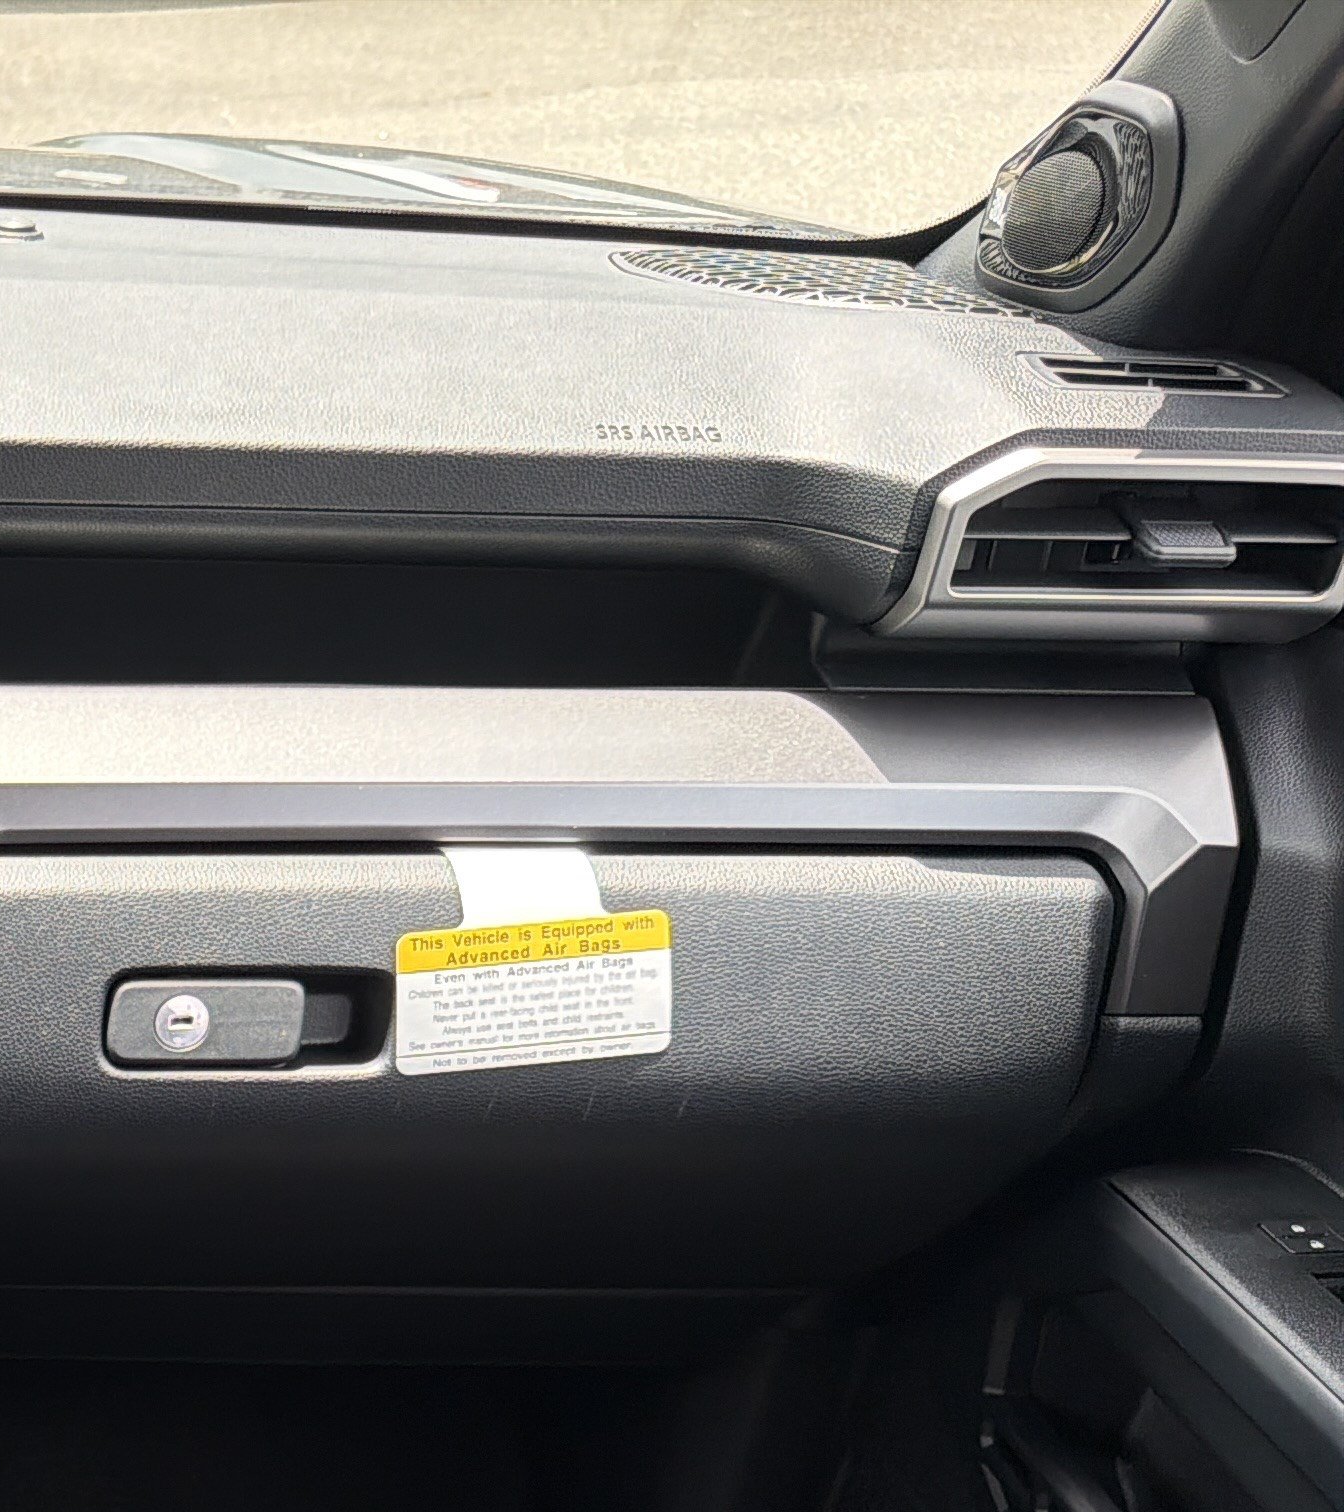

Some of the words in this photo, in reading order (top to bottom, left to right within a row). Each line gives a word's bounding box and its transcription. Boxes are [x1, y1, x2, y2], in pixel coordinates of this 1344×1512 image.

[595, 424, 633, 441] SRS
[640, 424, 722, 443] AIRBAG
[409, 936, 444, 952] This
[452, 930, 510, 947] Vehicle
[518, 927, 532, 942] is
[541, 920, 614, 941] Equipped
[622, 915, 655, 931] with
[446, 946, 531, 967] Advanced
[542, 942, 567, 957] Air
[579, 938, 621, 954] Bags
[434, 973, 466, 985] Even
[473, 968, 500, 981] with
[507, 962, 570, 977] Advanced
[576, 959, 595, 970] Air
[601, 957, 634, 970] Bags
[433, 1000, 450, 1011] The
[432, 1058, 451, 1068] Not
[472, 1056, 487, 1065] be
[491, 1050, 538, 1064] removed
[541, 1046, 576, 1058] except
[581, 1045, 594, 1056] by
